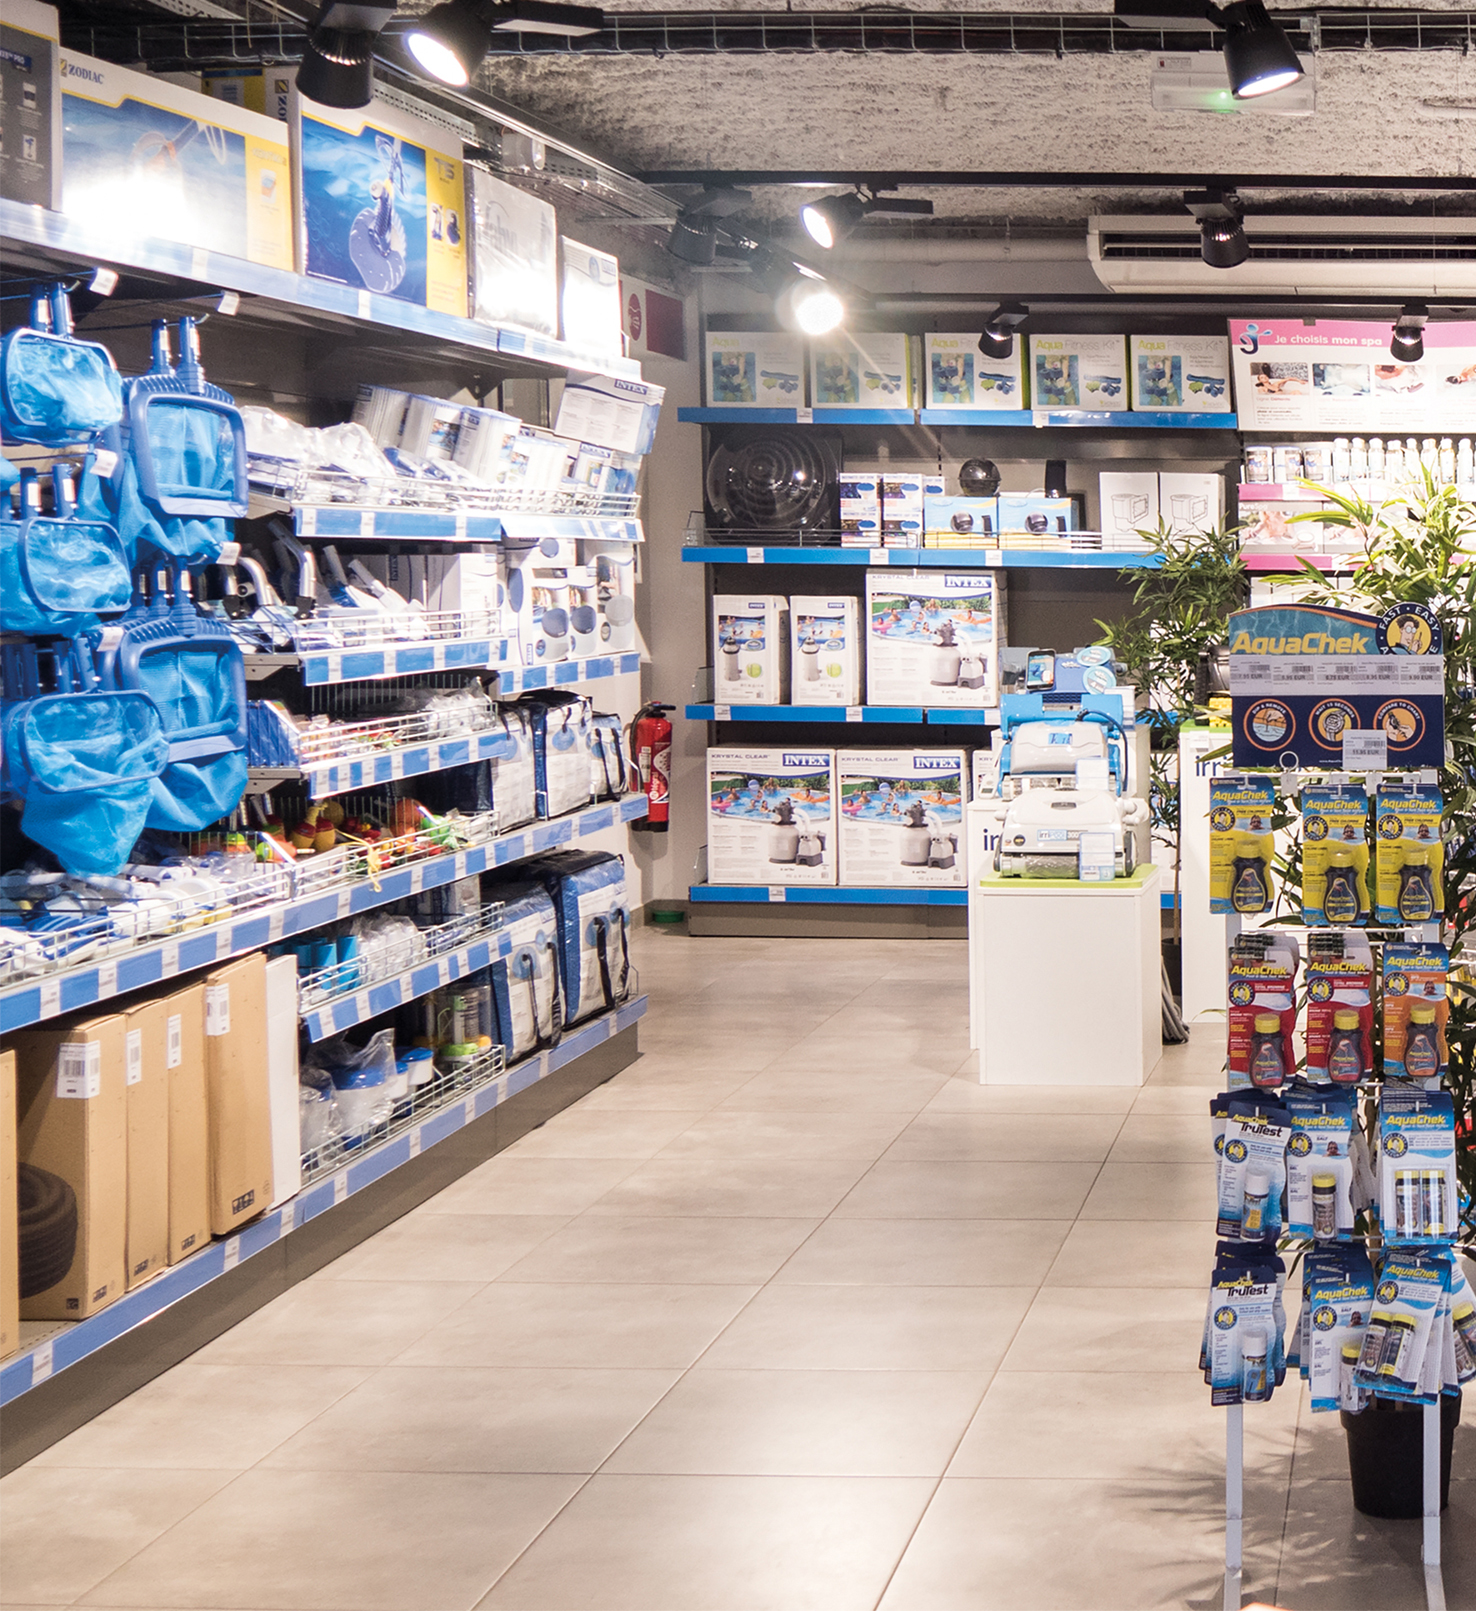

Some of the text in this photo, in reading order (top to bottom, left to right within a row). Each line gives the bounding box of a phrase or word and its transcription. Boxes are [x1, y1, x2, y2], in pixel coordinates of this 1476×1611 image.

[68, 63, 104, 85] ZODIAC
[930, 337, 959, 350] Aqua
[1035, 339, 1063, 351] Aqua
[1137, 339, 1165, 351] Aqua
[1274, 335, 1383, 347] Je choisis mon spa
[615, 380, 648, 394] INTEX
[946, 576, 990, 587] INTEX
[1379, 606, 1440, 632] FAST EASY
[1233, 633, 1369, 656] AquaChek
[784, 754, 828, 767] INTEX
[915, 757, 959, 769] INTEX
[1212, 790, 1268, 801] AquaChek
[1305, 799, 1362, 810] AquaChek
[1381, 798, 1437, 809] AquaChek
[1310, 962, 1366, 973] AquaChek
[1386, 956, 1442, 967] AquaChek
[1231, 965, 1287, 976] AquaChek
[1232, 1114, 1268, 1125] AquaChek
[1291, 1116, 1345, 1127] AquaChek
[1386, 1114, 1446, 1127] AquaChek
[1240, 1122, 1283, 1137] TruTest
[1386, 1264, 1440, 1279] AquaChek
[1217, 1280, 1254, 1289] AquaChek
[1226, 1285, 1269, 1297] TruTest
[1315, 1285, 1369, 1300] AquaChek
